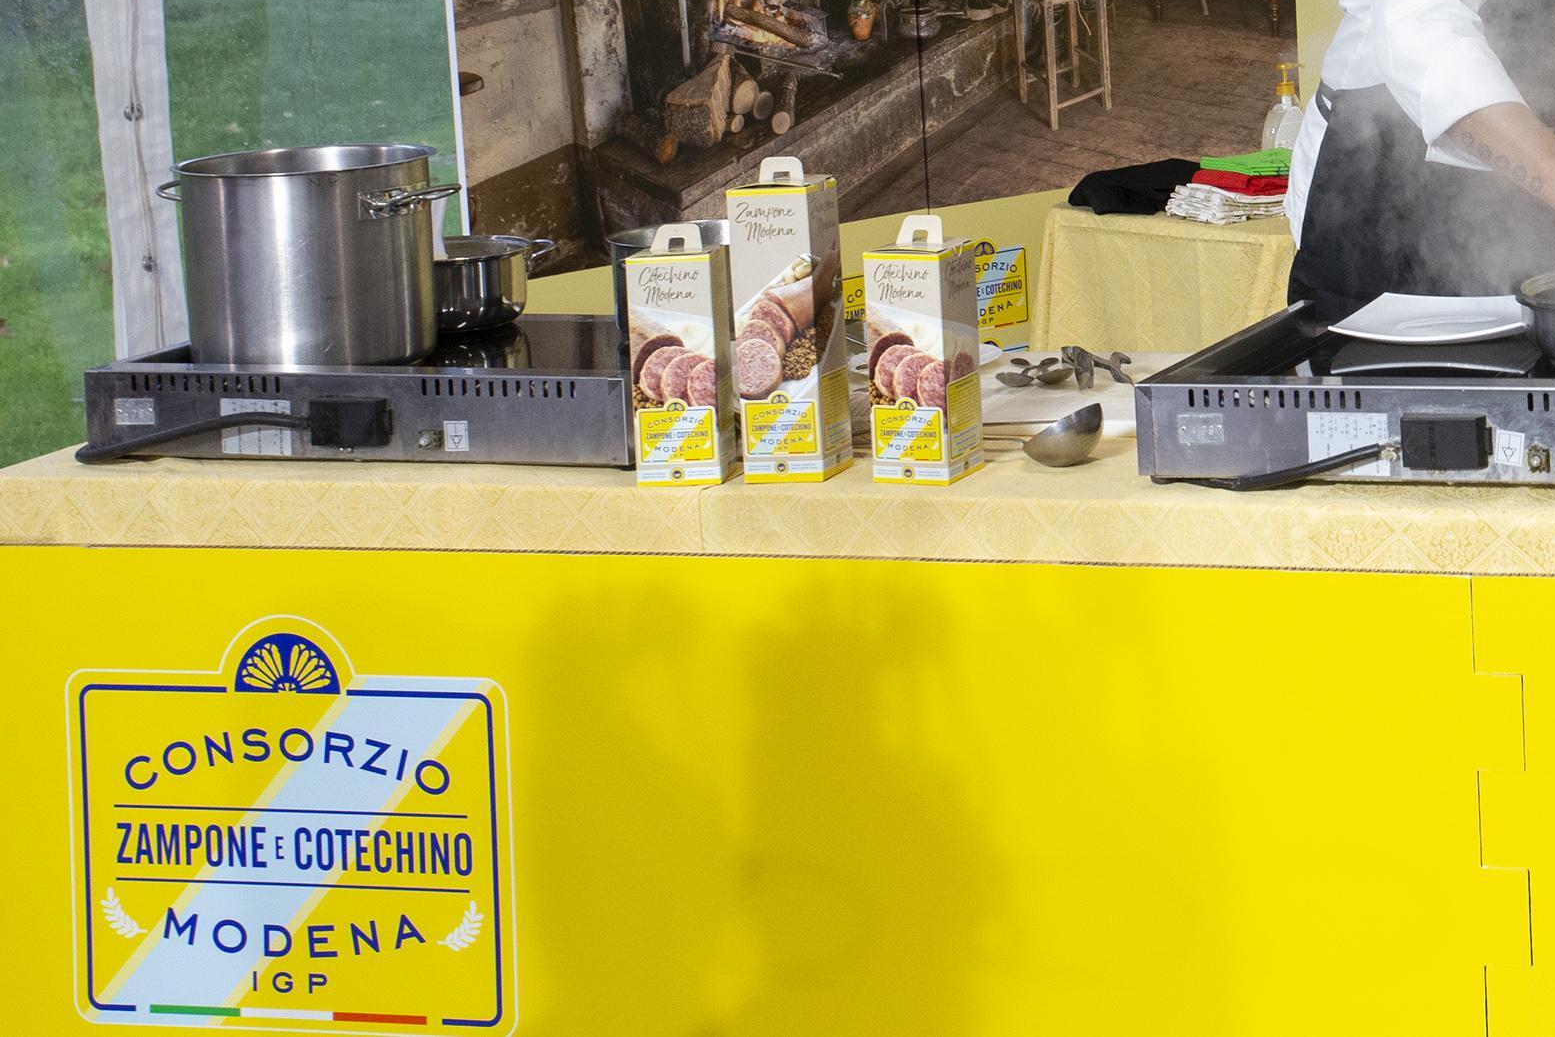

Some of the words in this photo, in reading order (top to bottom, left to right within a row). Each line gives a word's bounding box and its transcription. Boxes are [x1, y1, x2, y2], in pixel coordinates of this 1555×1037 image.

[735, 202, 796, 224] Zampone
[745, 221, 796, 245] Modena
[639, 266, 699, 287] Cotechino
[873, 263, 930, 283] Cotechino
[643, 285, 696, 307] Modena
[878, 282, 926, 304] Modena
[985, 279, 1023, 296] COTECHINO
[979, 300, 1013, 317] DENA
[647, 416, 705, 429] CONSORZIO
[752, 408, 808, 421] CONSORZIO
[880, 415, 933, 427] CONSORZIO
[654, 443, 700, 453] MODENA
[760, 436, 803, 445] MODENA
[887, 443, 929, 452] MODENA
[124, 728, 451, 796] CONSORZIO
[116, 822, 267, 869] ZAMPONE
[275, 836, 285, 860] E
[294, 827, 473, 877] COTECHINO
[163, 907, 427, 959] MODENA
[252, 971, 328, 994] IGP
